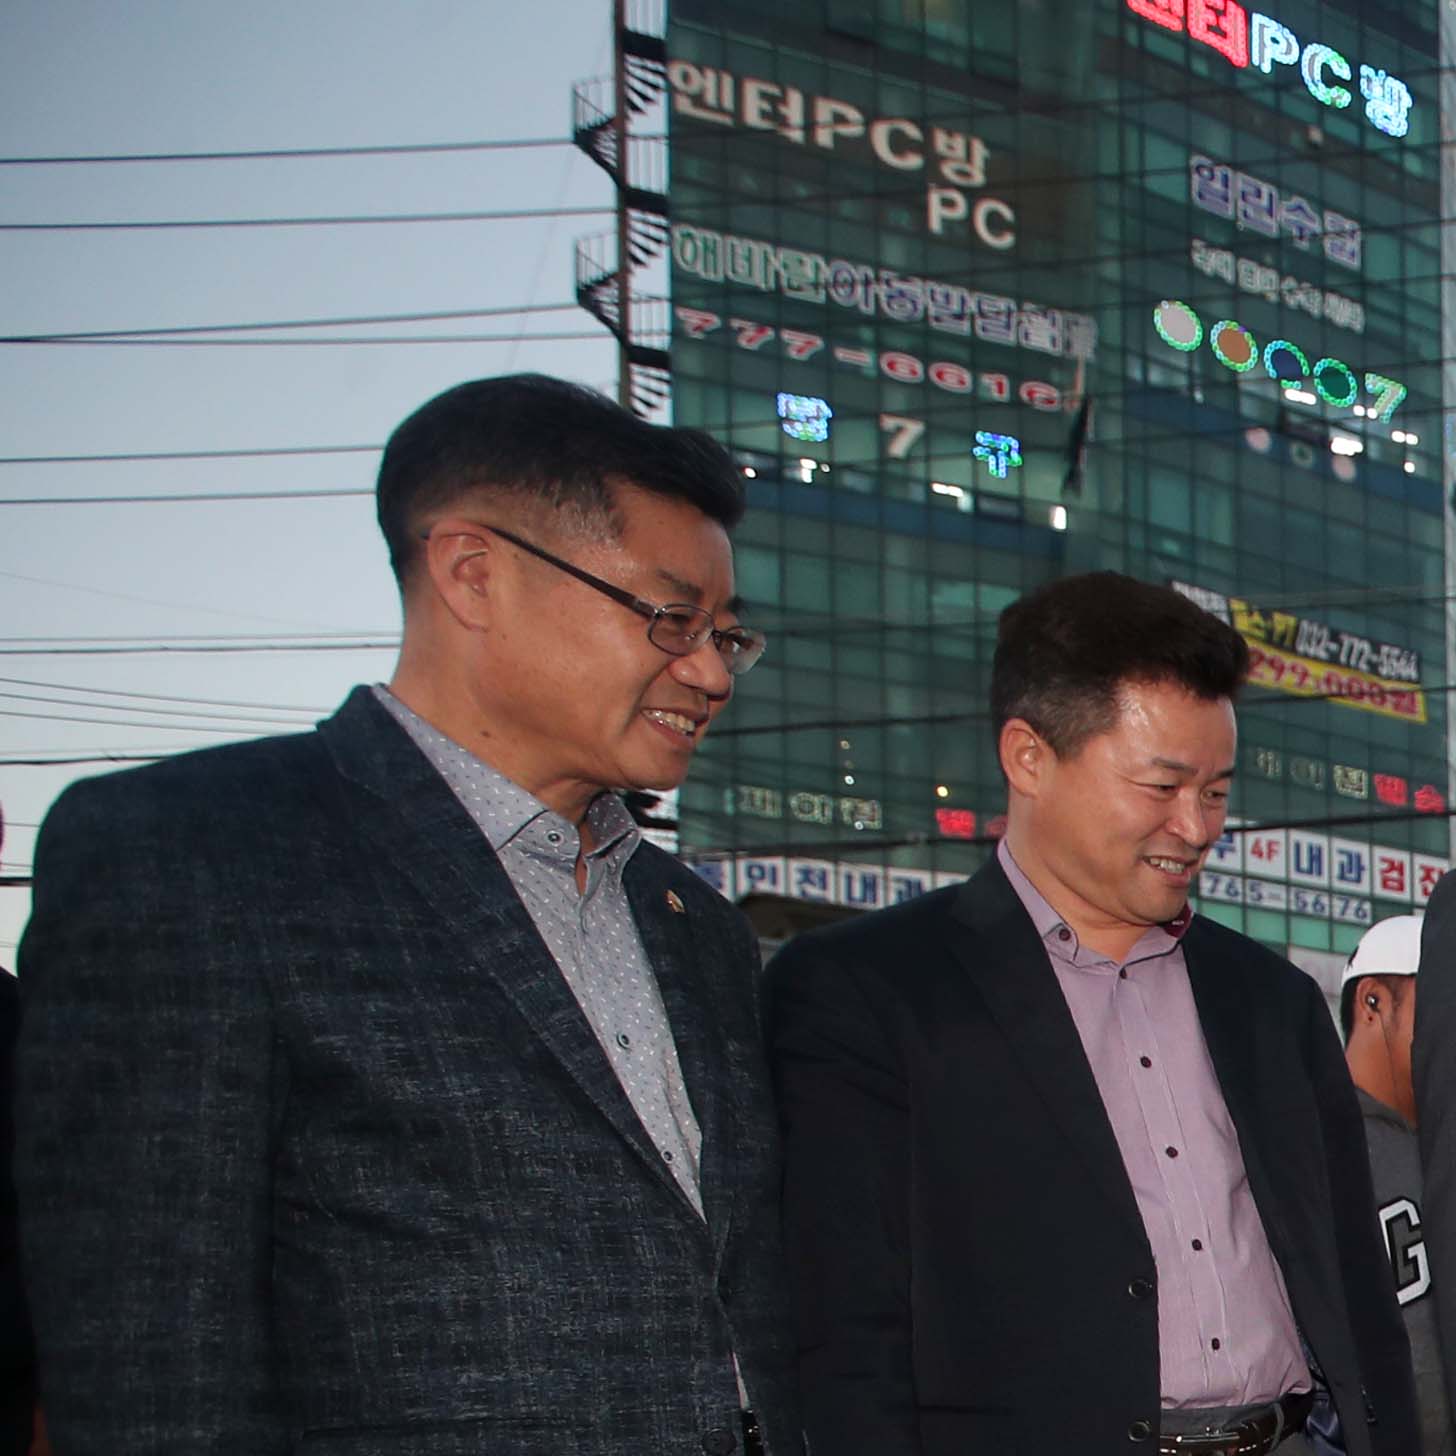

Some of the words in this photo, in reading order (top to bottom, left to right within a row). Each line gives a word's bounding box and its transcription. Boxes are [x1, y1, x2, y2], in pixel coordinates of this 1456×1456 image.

[666, 60, 991, 188] 엔터PC방
[926, 184, 1016, 250] PC
[1250, 837, 1281, 863] 4F
[1293, 840, 1366, 884] 내과
